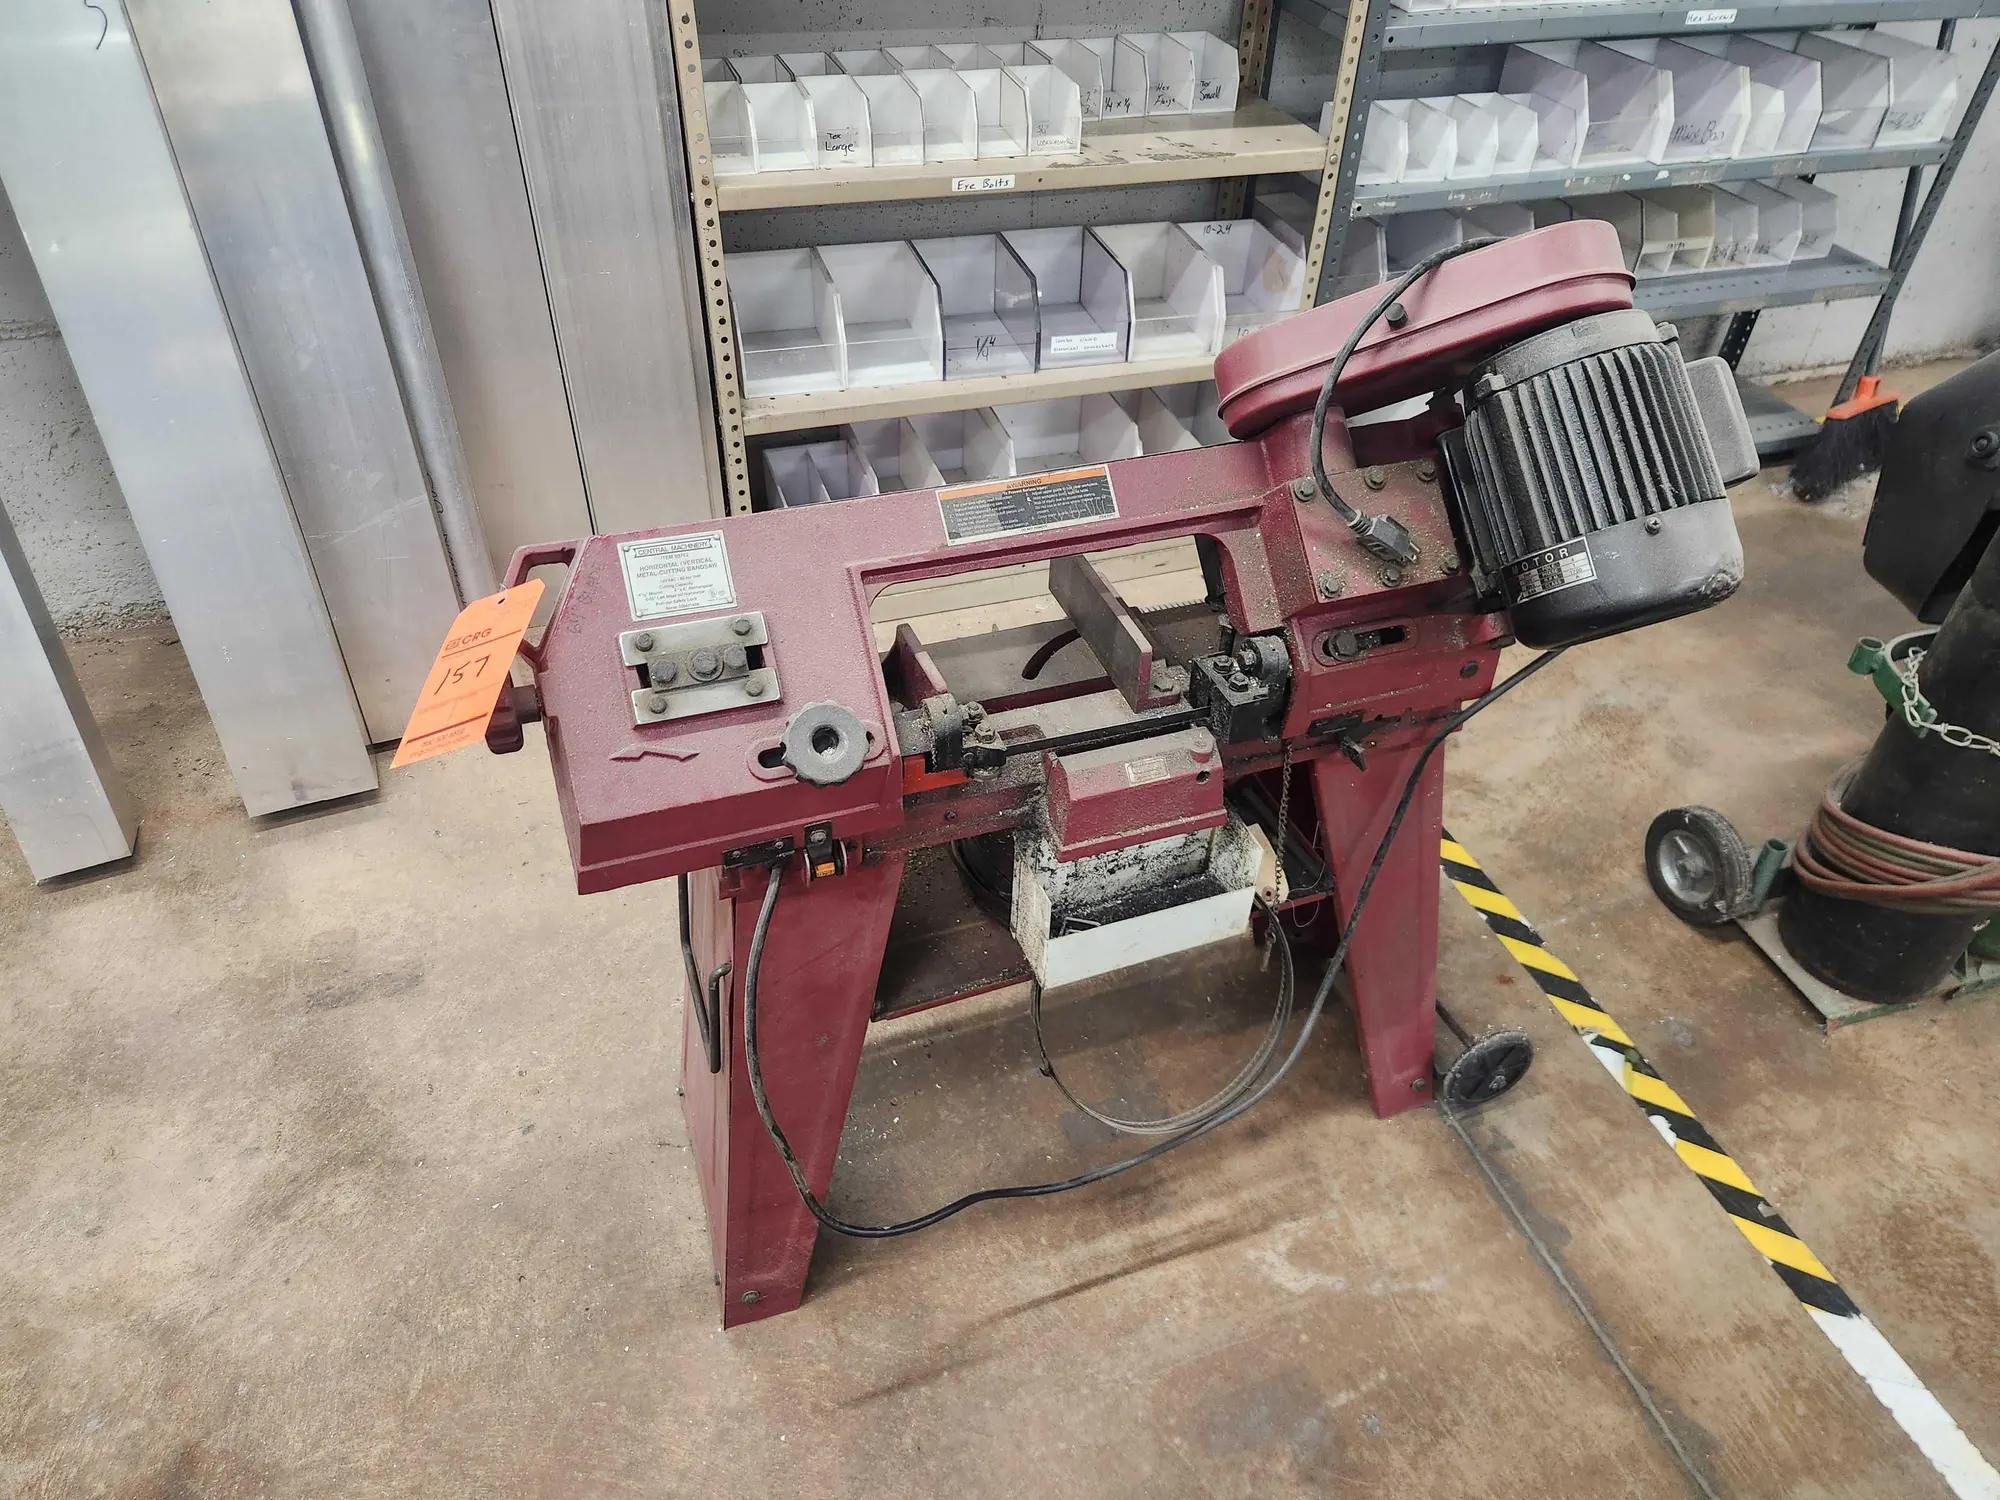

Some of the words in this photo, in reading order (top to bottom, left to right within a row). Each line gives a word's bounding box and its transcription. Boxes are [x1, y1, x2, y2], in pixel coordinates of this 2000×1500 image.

[825, 141, 855, 157] Large
[982, 178, 1009, 188] Bolts
[1009, 479, 1042, 490] WARNING
[637, 546, 669, 556] CENTRAL
[671, 541, 708, 551] MACHINERY
[639, 561, 679, 572] HORIZONTAL
[1512, 547, 1569, 575] MOTOR
[636, 567, 686, 579] METAL-CUTTING
[687, 562, 718, 572] BANDSAW
[462, 628, 492, 646] CRG
[433, 654, 491, 696] 157
